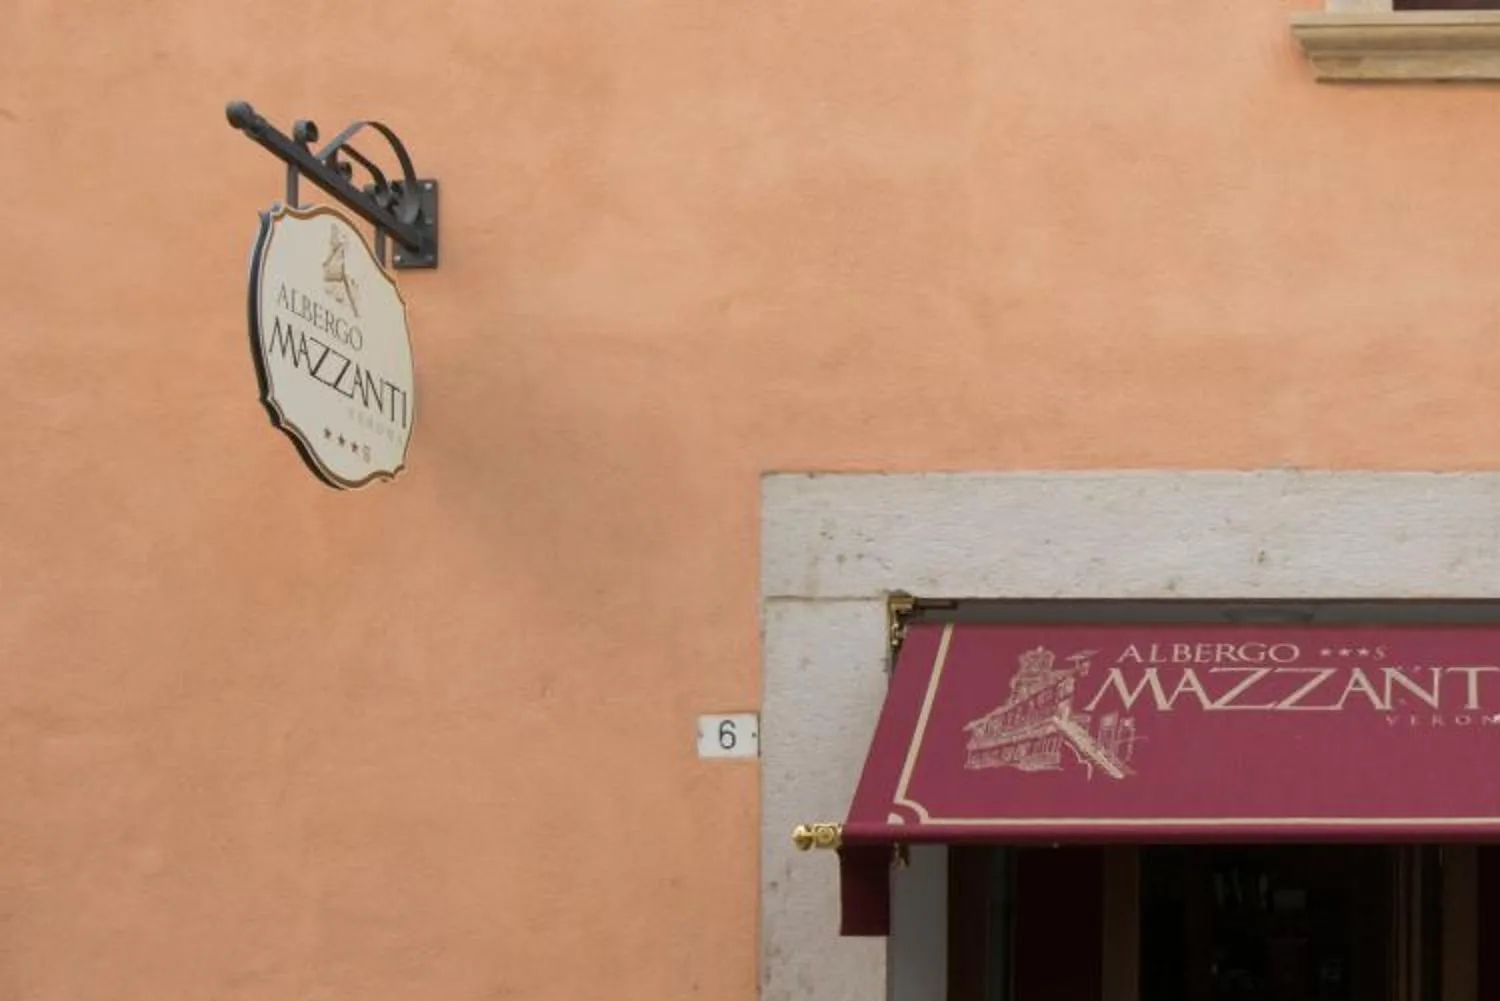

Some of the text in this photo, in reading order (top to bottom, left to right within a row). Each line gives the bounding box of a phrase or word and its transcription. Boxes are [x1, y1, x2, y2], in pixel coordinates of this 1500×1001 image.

[278, 282, 363, 351] ALBERGO
[269, 316, 407, 429] MAZZANTI
[1116, 642, 1300, 664] ALBERGO
[718, 719, 737, 750] 6
